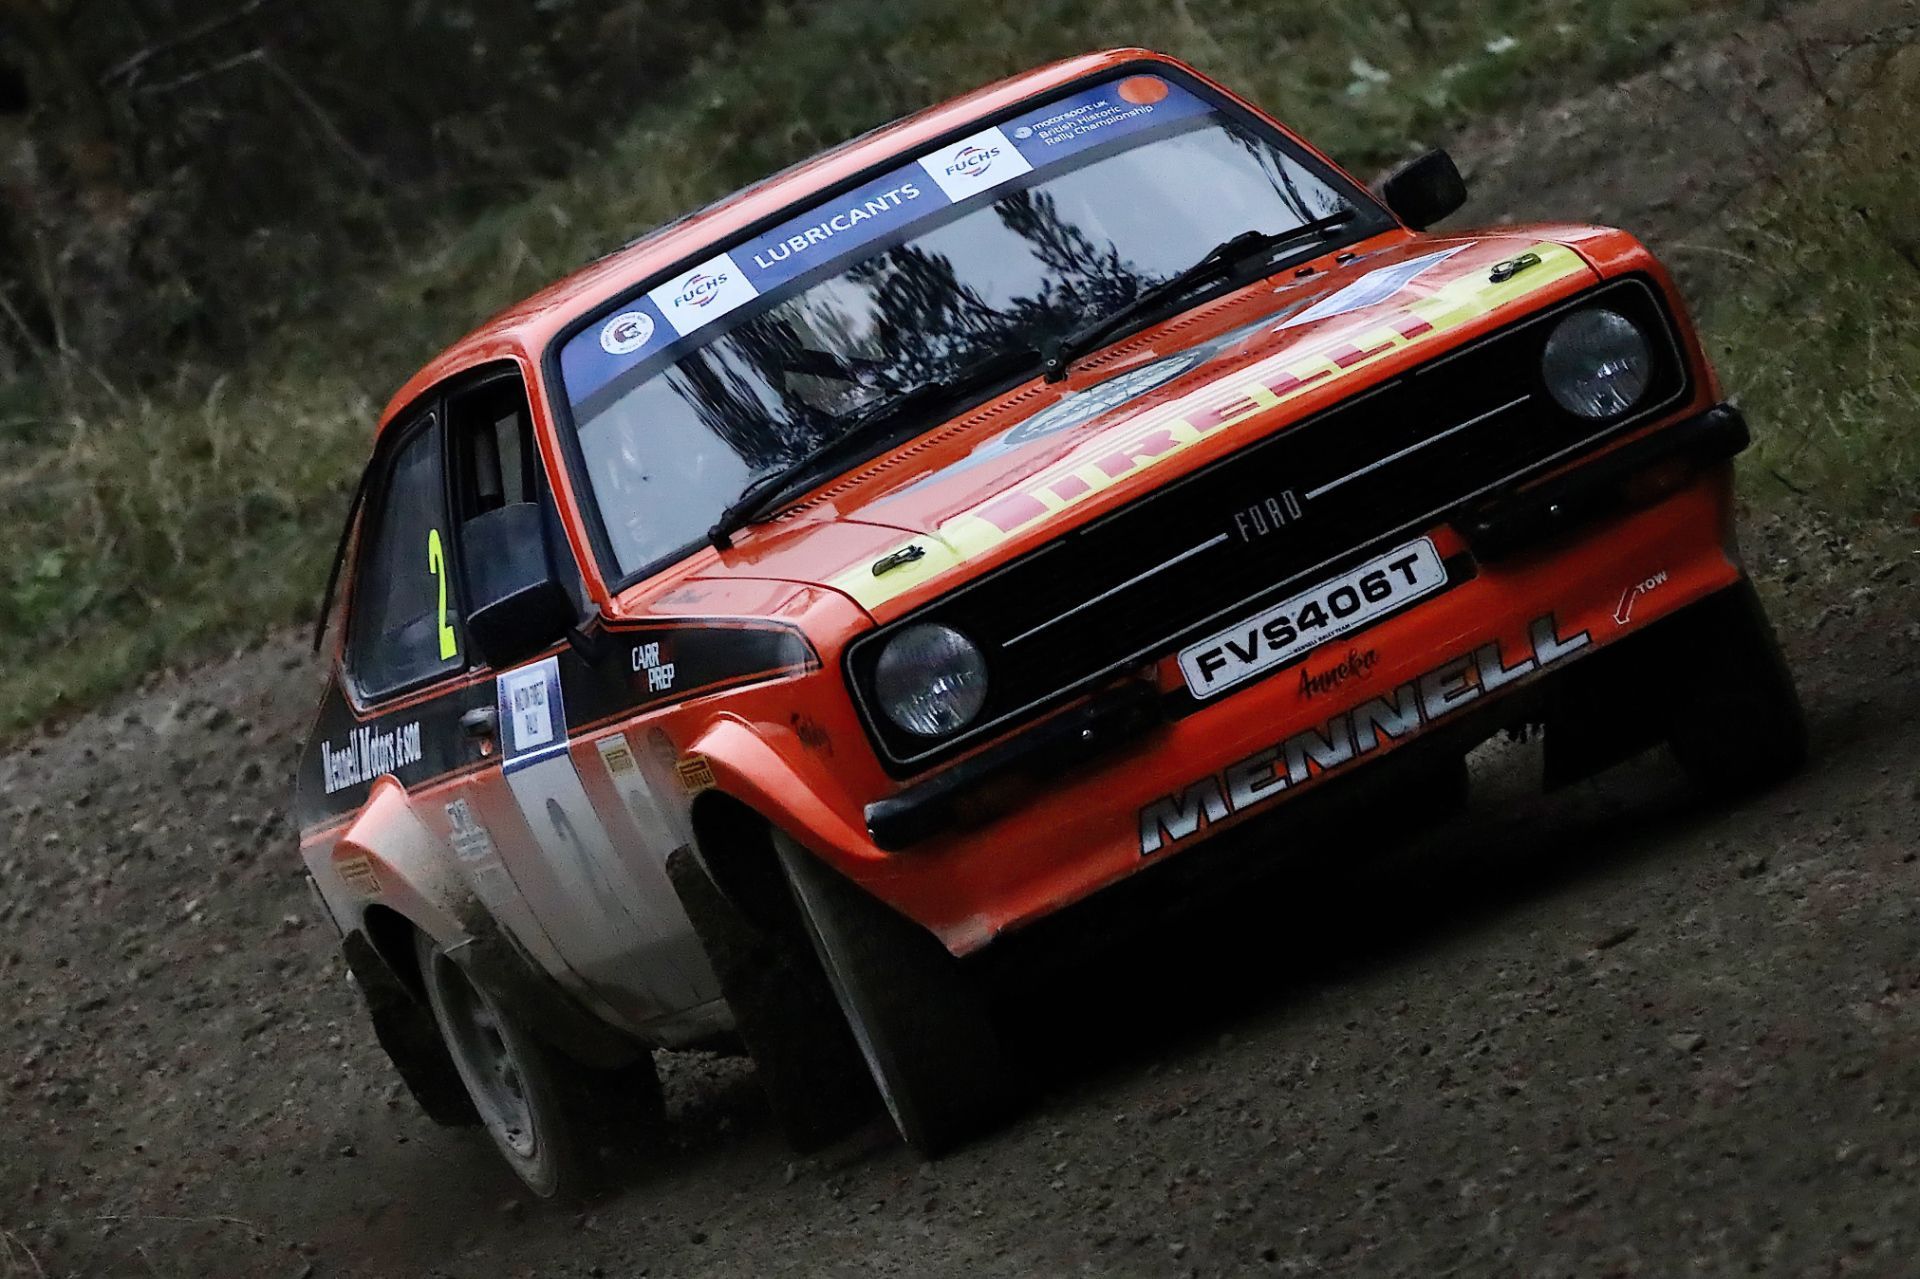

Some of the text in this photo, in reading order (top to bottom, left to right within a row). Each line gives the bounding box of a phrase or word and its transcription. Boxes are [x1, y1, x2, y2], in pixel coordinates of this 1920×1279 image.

[1032, 104, 1094, 131] motorsport
[1038, 105, 1121, 139] British Historic
[1045, 104, 1154, 146] Rally Championship
[944, 146, 1001, 177] FUCHS
[753, 183, 921, 269] LUBRICANTS
[673, 273, 729, 309] FUCHS
[1233, 489, 1303, 542] FORD
[428, 529, 457, 660] 2
[1635, 571, 1668, 594] TOW
[1195, 552, 1419, 683] FVS406T
[631, 641, 660, 672] CARR
[647, 662, 675, 693] PREP
[1139, 611, 1593, 856] MENNELL
